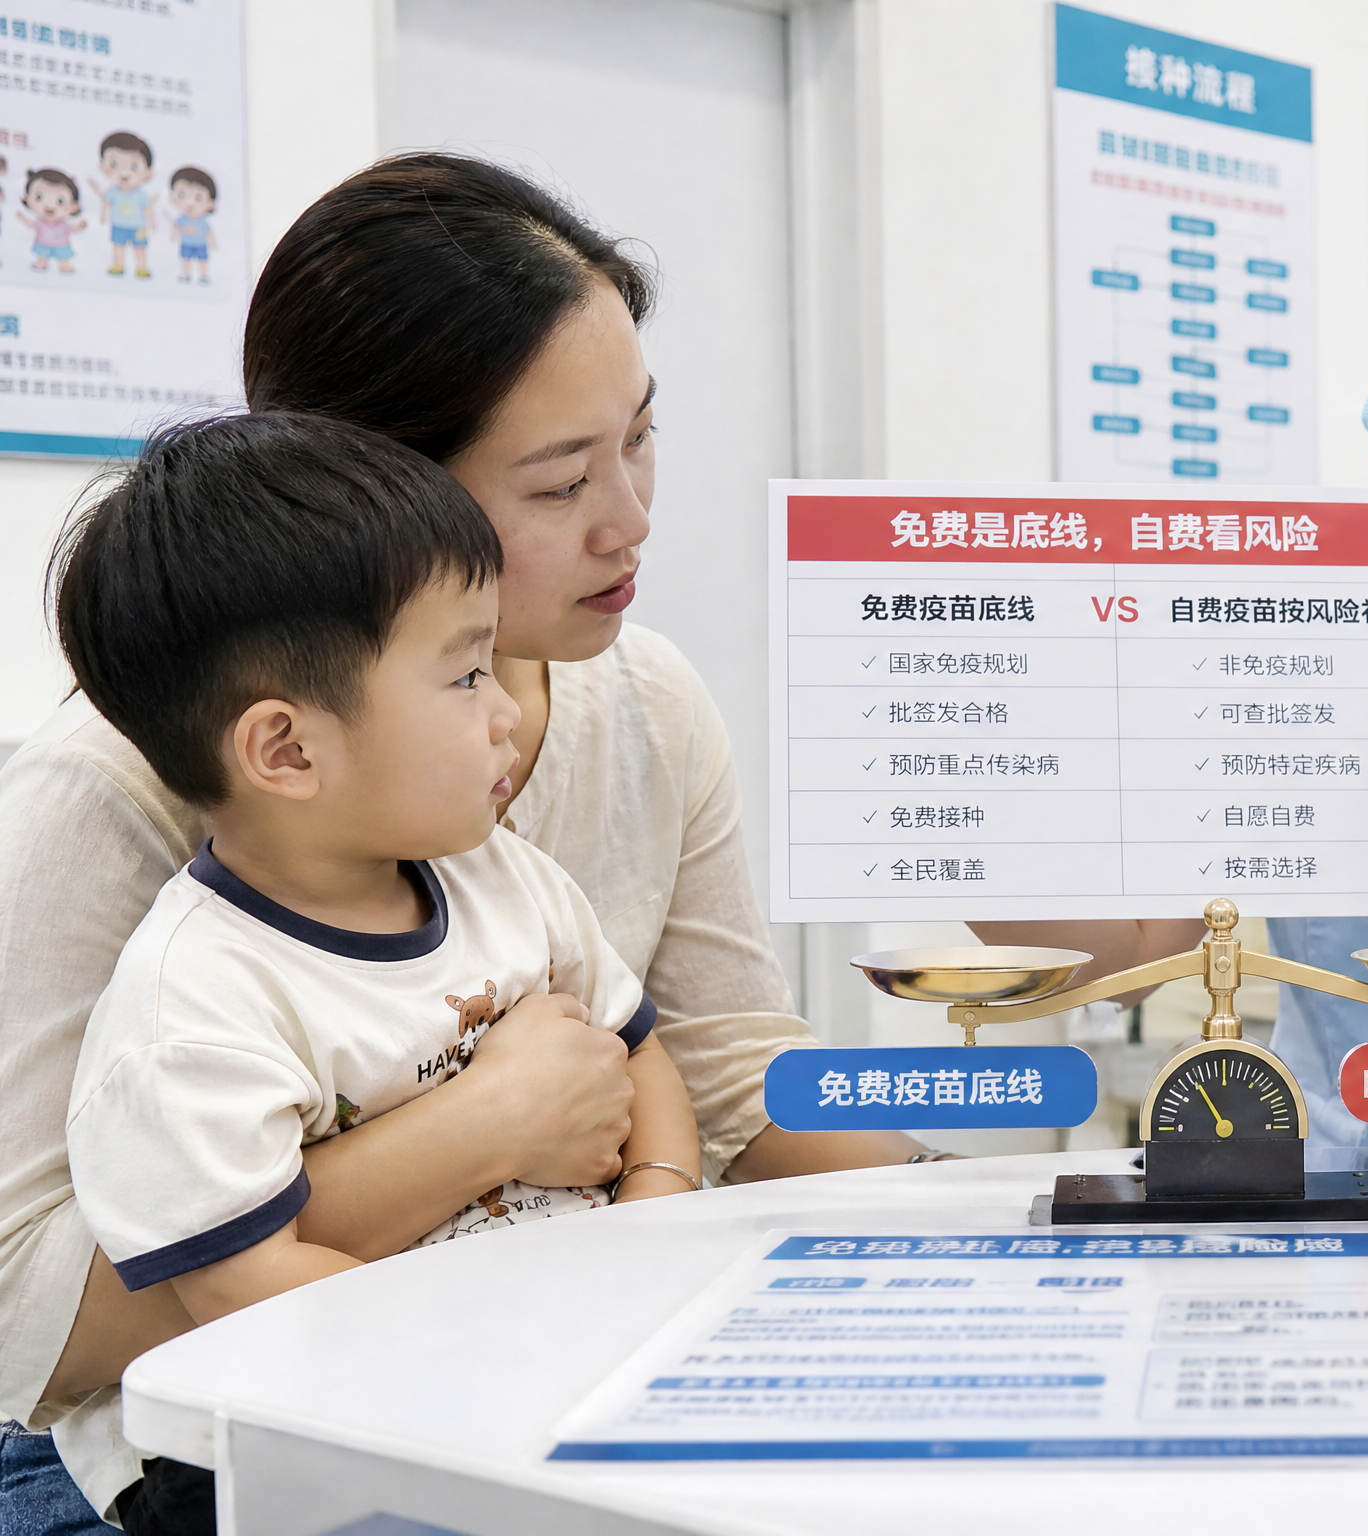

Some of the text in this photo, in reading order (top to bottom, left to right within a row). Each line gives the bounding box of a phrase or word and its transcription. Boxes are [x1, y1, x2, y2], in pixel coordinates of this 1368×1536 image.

[891, 510, 1318, 552] 免费是底线，自费看风险
[861, 594, 1035, 622] 免费疫苗底线
[1090, 596, 1139, 622] VS
[889, 653, 1028, 675] 国家免疫规划
[1219, 654, 1334, 676] 非免疫规划
[889, 702, 1009, 724] 批签发合格
[1220, 703, 1336, 725] 可查批签发
[889, 753, 1059, 776] 预防重点传染病
[1222, 754, 1361, 776] 预防特定疾病
[890, 806, 984, 828] 免费接种
[1224, 805, 1315, 827] 自愿自费
[890, 858, 986, 882] 全民覆盖
[1224, 857, 1318, 879] 按需选择
[418, 1041, 466, 1083] HAVE
[817, 1068, 1043, 1107] 免费疫苗底线
